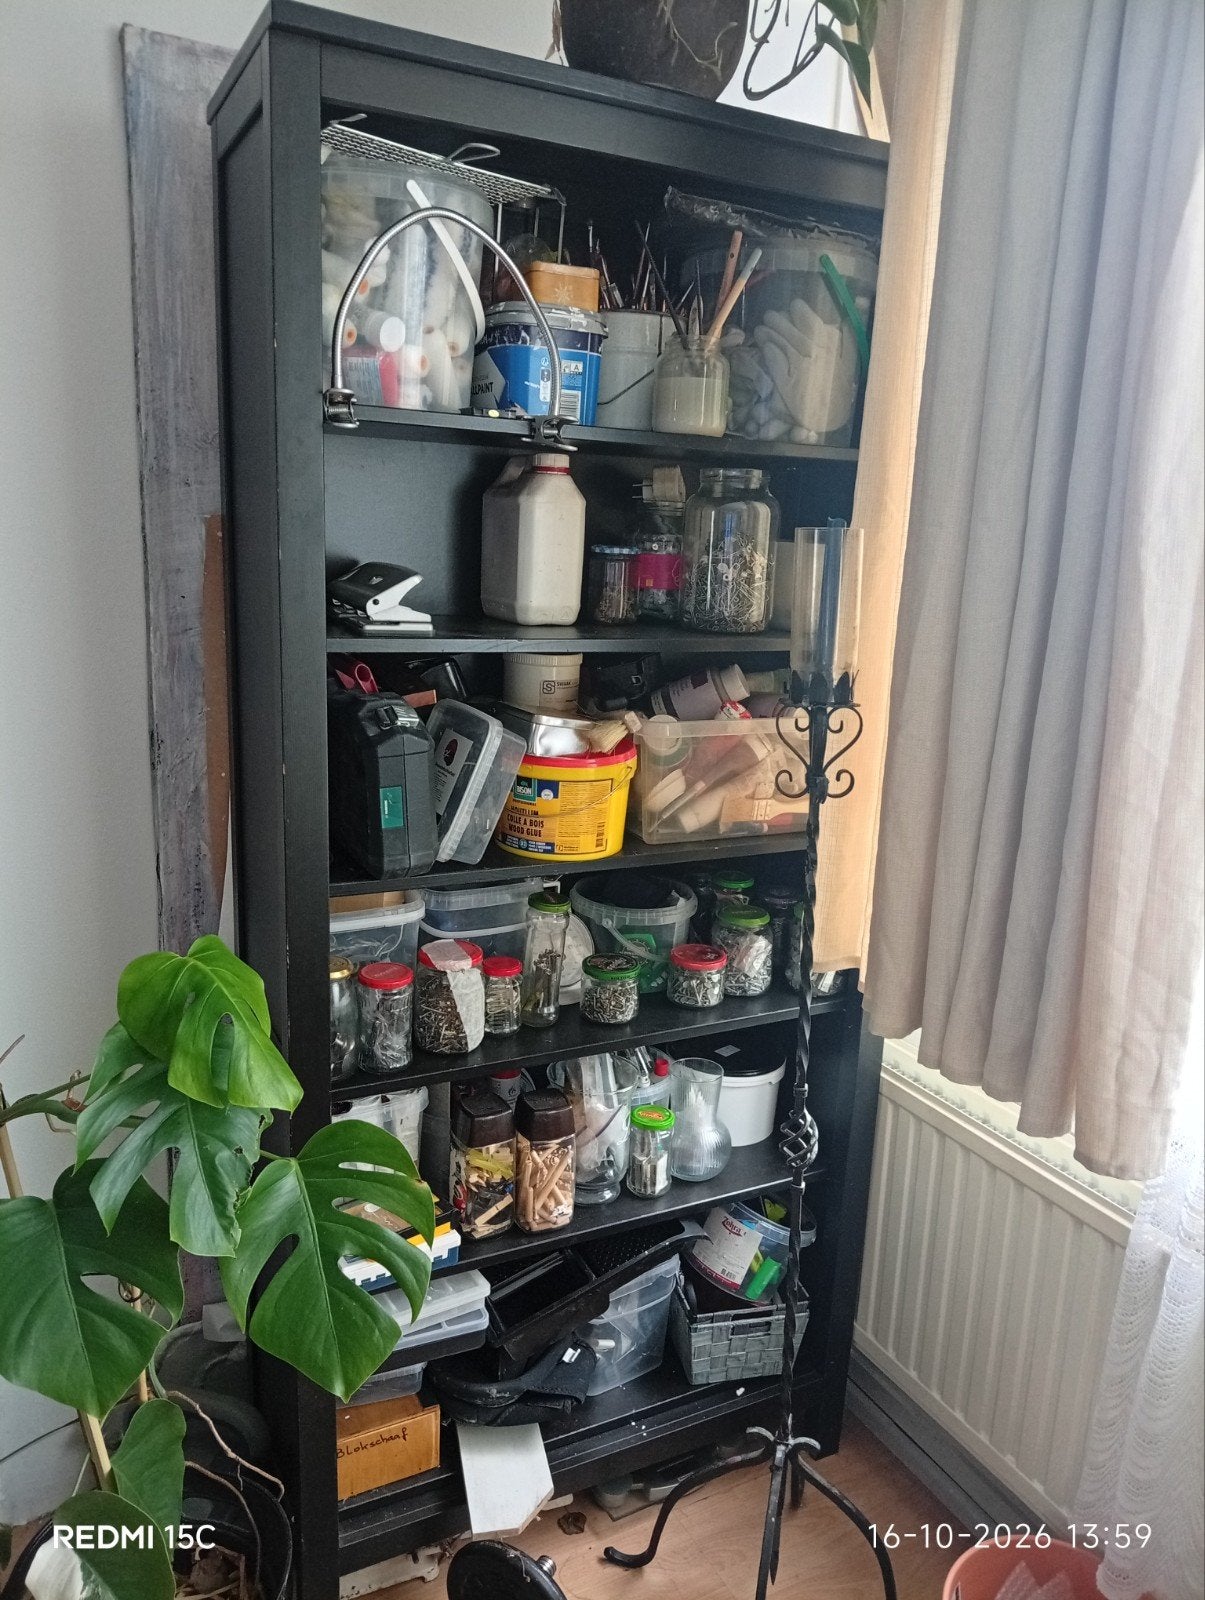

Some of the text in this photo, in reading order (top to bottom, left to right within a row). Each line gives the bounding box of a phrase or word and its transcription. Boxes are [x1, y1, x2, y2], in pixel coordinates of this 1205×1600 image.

[508, 824, 542, 838] WOOD GLUE
[529, 819, 545, 829] BOIS
[721, 1216, 742, 1237] Zohra
